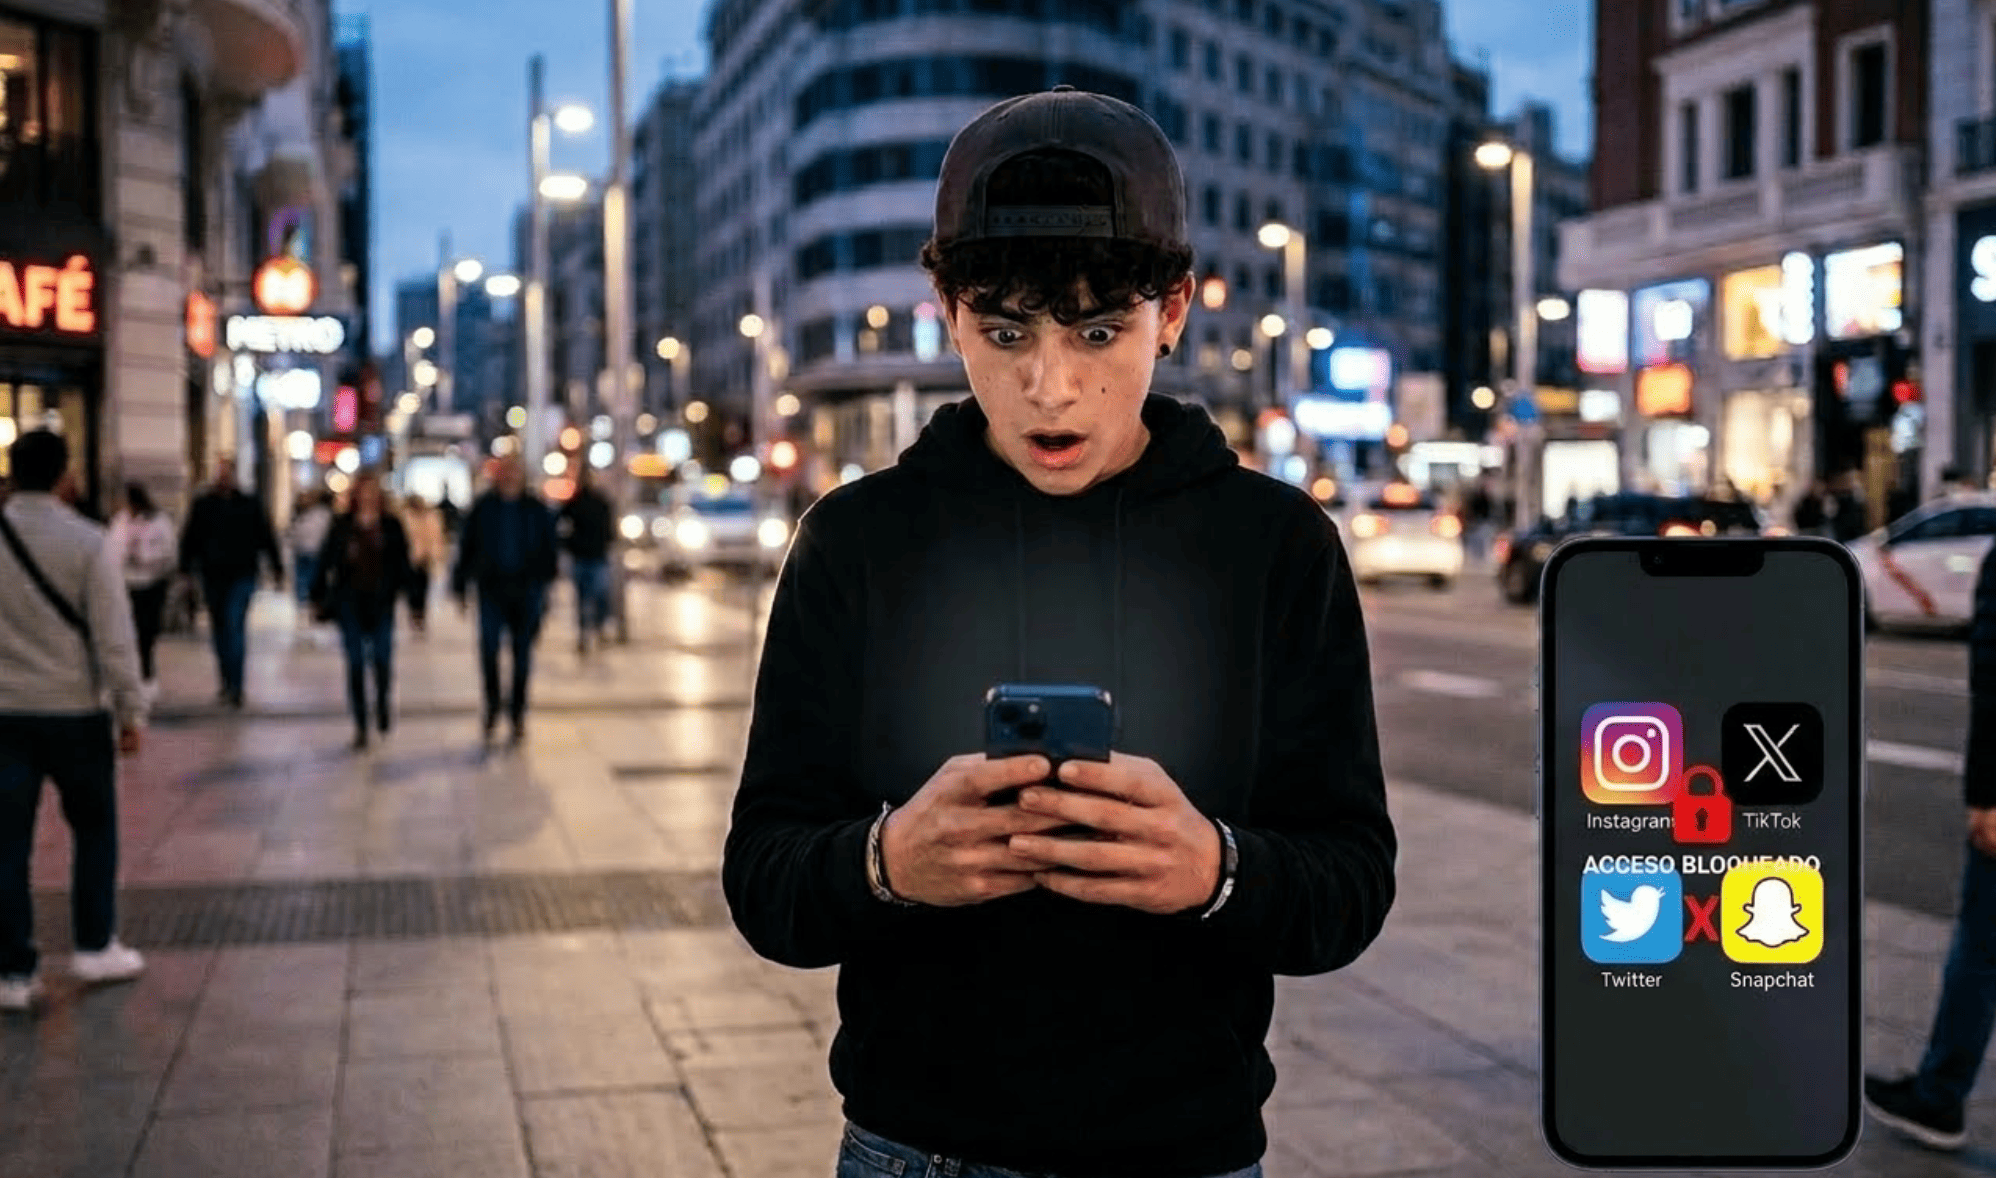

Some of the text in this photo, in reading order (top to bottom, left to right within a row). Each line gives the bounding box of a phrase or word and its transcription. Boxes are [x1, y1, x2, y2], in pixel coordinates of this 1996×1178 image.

[1742, 812, 1801, 829] TikTok
[1583, 855, 1676, 875] ACCESO
[1601, 971, 1663, 988] Twitter
[1730, 971, 1815, 991] Snapchat
